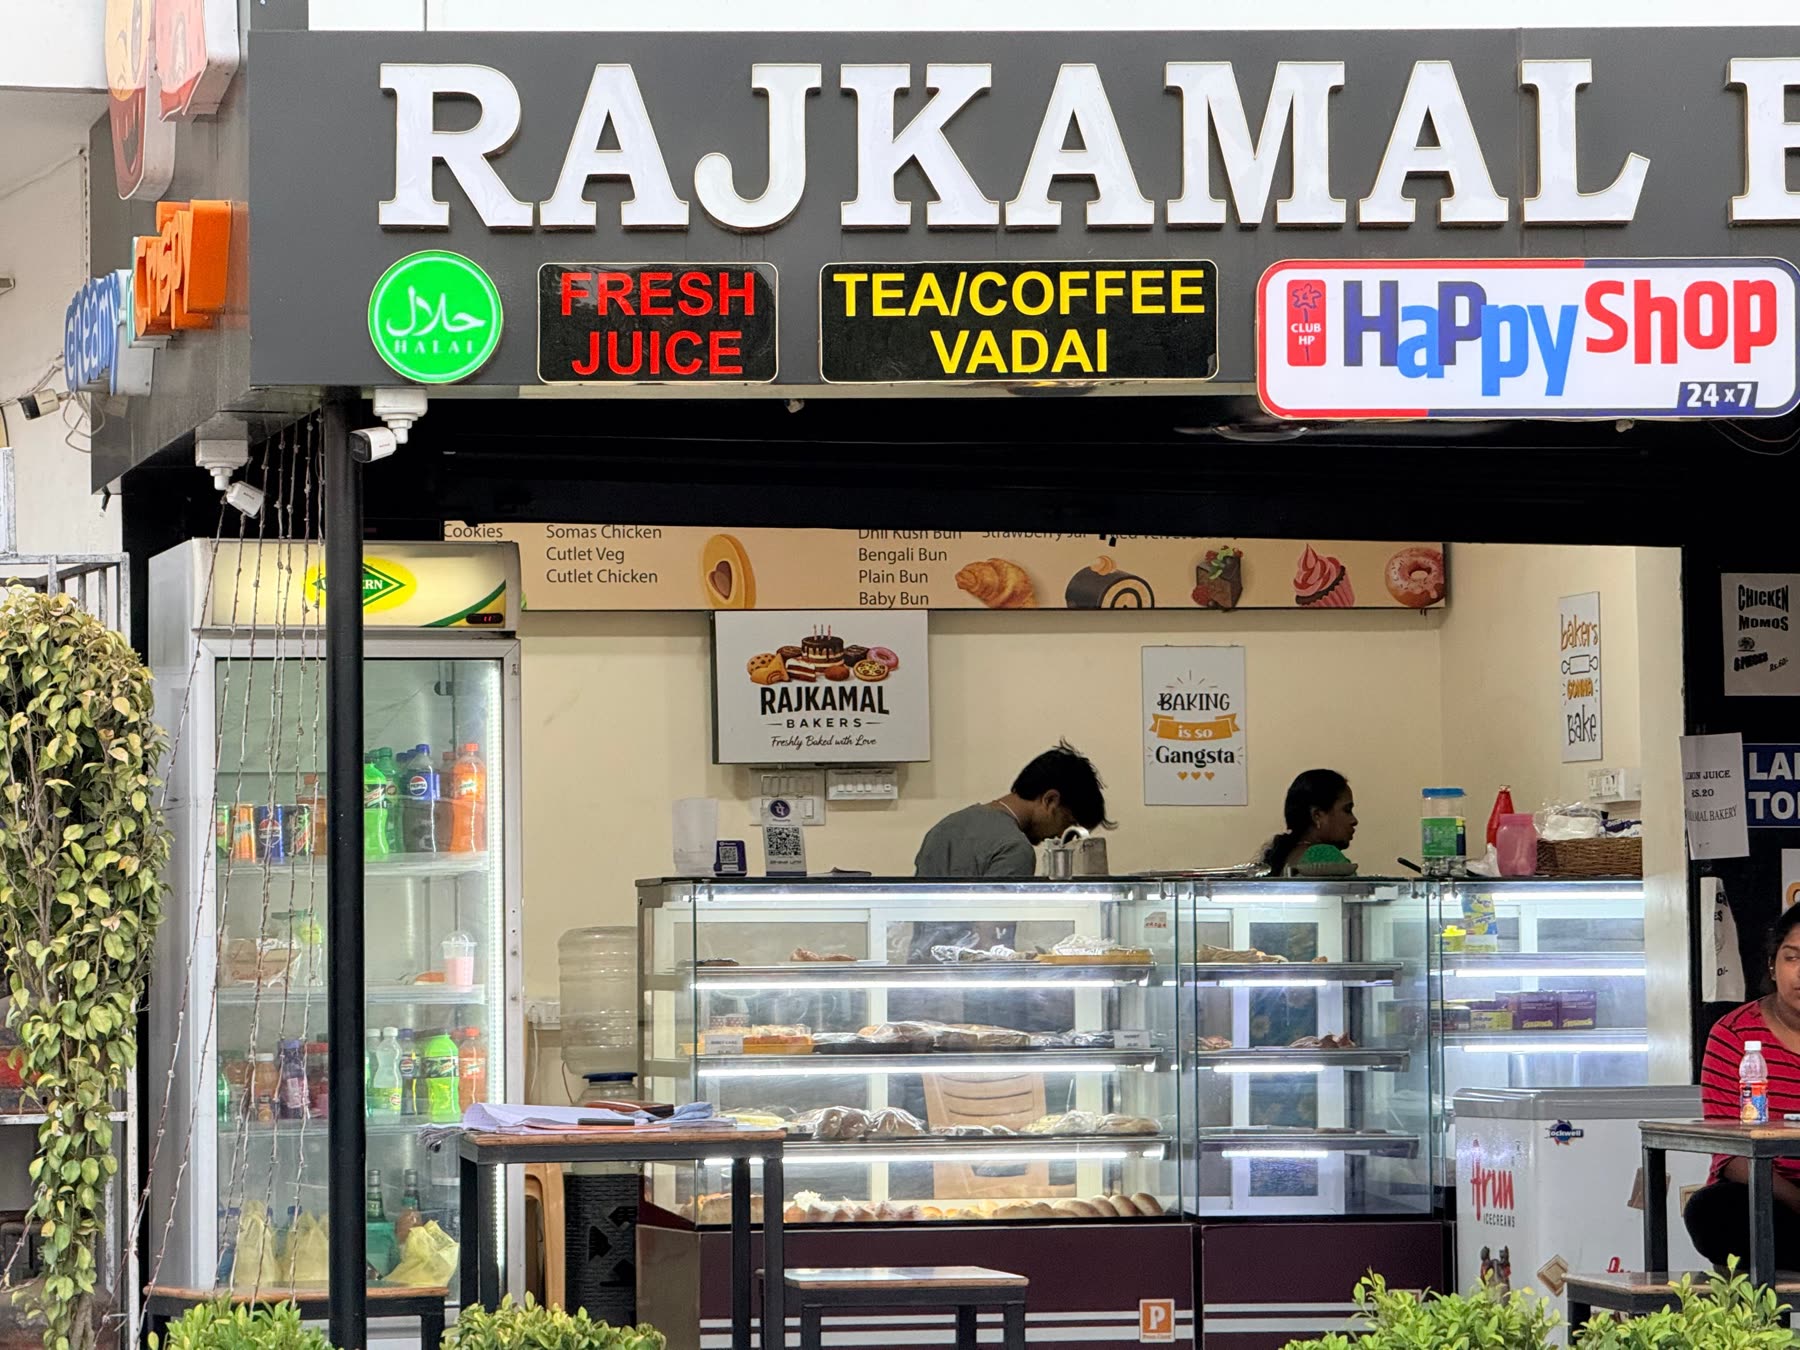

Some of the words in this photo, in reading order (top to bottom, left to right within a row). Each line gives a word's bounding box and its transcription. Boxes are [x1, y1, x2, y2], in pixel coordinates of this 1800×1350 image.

[379, 59, 1650, 229] RAJKAMAL
[561, 272, 754, 316] FRESH
[832, 269, 1206, 317] TEA/COFFEE
[386, 285, 486, 337] حلال
[1291, 323, 1322, 334] CLUB
[1298, 335, 1316, 346] HP
[571, 330, 743, 376] JUICE
[930, 328, 1108, 374] VADAI
[546, 525, 597, 539] Somas
[601, 525, 662, 540] Chicken
[546, 548, 593, 562] Cutlet
[596, 548, 625, 565] Veg
[858, 547, 914, 565] Bengali
[918, 547, 948, 562] Bun
[546, 570, 593, 584] Cutlet
[597, 570, 658, 584] Chicken
[858, 569, 894, 584] Plain
[899, 570, 928, 584] Bun
[858, 591, 894, 609] Baby
[899, 592, 929, 606] Bun
[1737, 584, 1789, 613] CHICKEN
[1560, 614, 1598, 651] bakers
[760, 685, 890, 716] RAJKAMAL
[1157, 693, 1230, 711] BAKING
[786, 718, 862, 729] BAKERS
[1178, 725, 1191, 738] is
[1194, 728, 1213, 739] so
[771, 736, 803, 751] Freshly
[806, 736, 833, 747] Baked
[835, 735, 853, 747] with
[855, 735, 877, 747] Love
[1155, 746, 1235, 769] Gangsta
[1749, 752, 1800, 780] LA
[1703, 769, 1731, 780] JUICE
[1709, 805, 1737, 821] BAKERY
[1748, 791, 1800, 820] TO
[1546, 1129, 1581, 1138] ockwell
